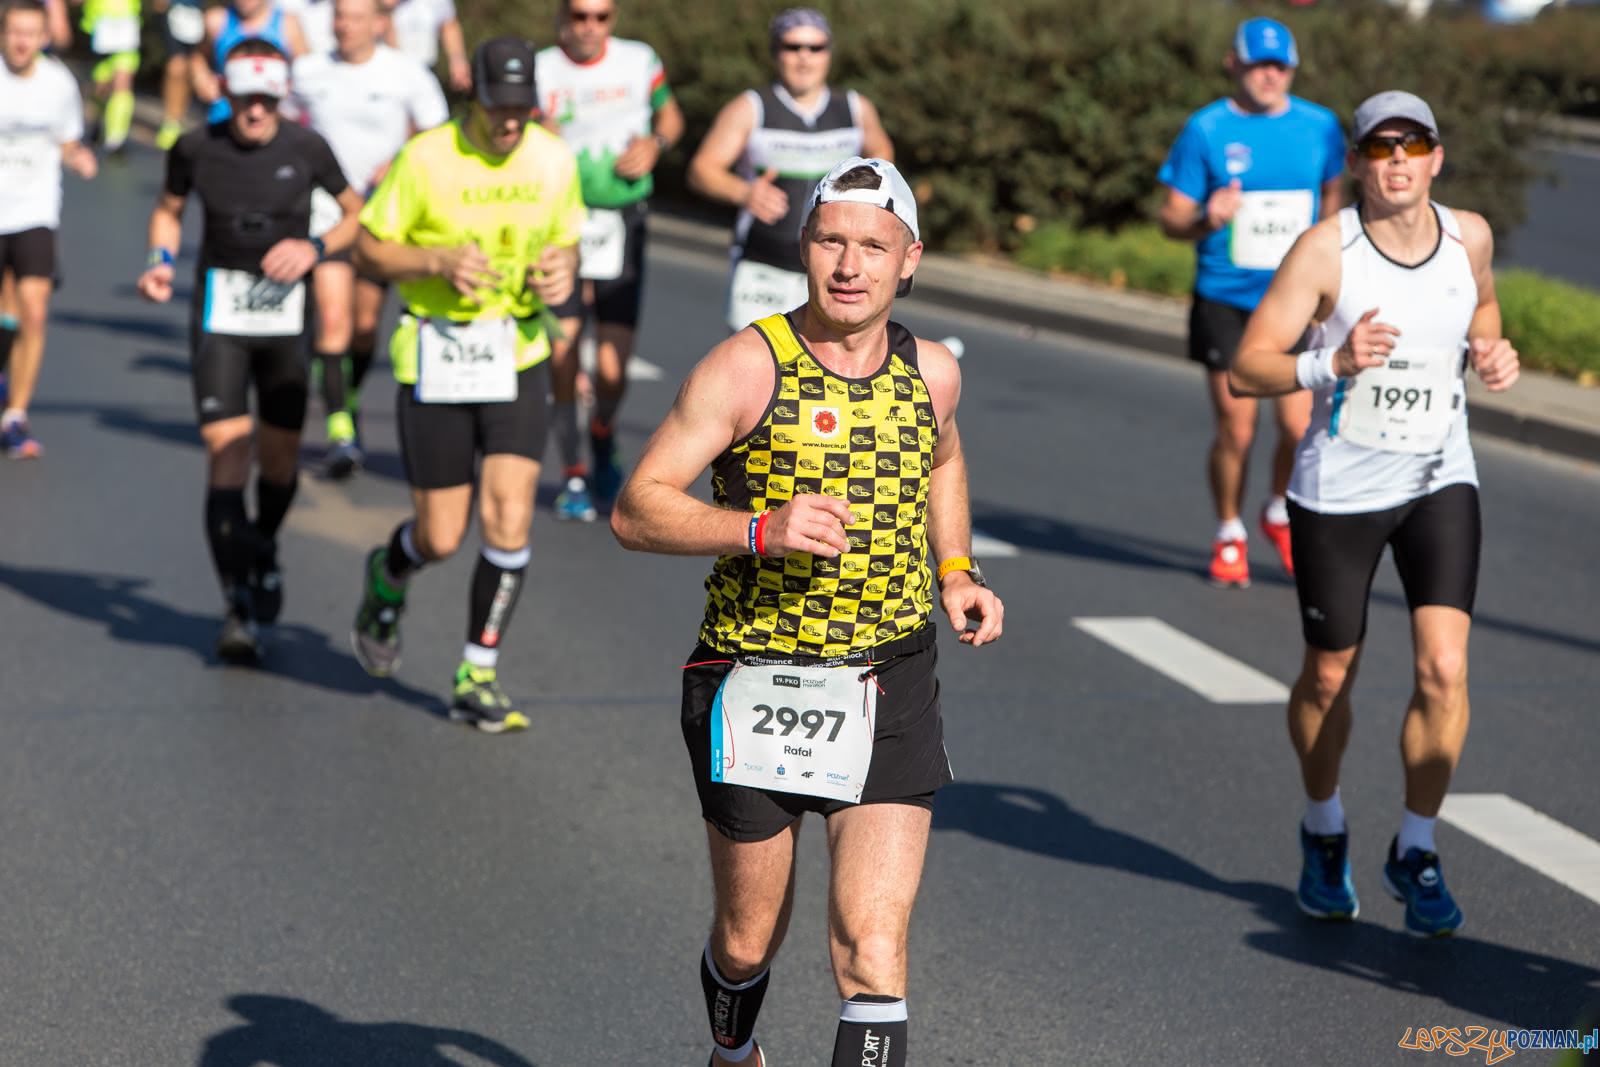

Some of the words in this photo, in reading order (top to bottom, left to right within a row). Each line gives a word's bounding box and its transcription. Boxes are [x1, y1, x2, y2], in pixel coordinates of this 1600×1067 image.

[1371, 385, 1433, 411] 1991
[801, 442, 847, 450] www.barcin.pl
[752, 704, 846, 742] 2997
[784, 745, 812, 757] Rafał
[801, 771, 815, 779] 4F
